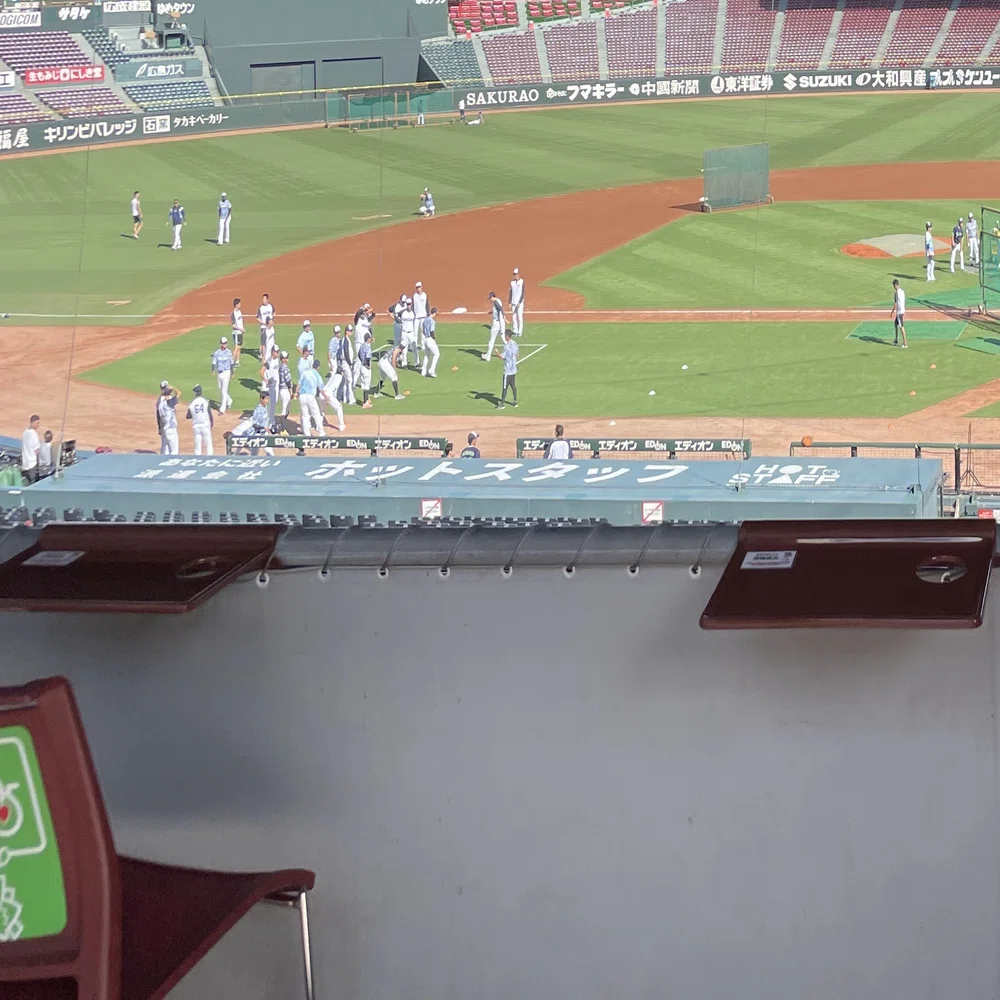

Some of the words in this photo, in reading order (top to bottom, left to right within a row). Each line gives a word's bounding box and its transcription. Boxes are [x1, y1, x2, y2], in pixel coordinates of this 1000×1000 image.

[58, 6, 91, 20] サタケ
[157, 2, 195, 15] ゆめタウン
[29, 70, 60, 82] 生もみじ
[147, 64, 185, 77] 広島ガス
[725, 74, 773, 92] 東洋証券
[799, 74, 852, 88] SUZUKI
[872, 69, 926, 88] 大和興産
[466, 88, 539, 106] SAKURAO
[567, 83, 624, 101] フマキラー
[173, 113, 229, 127] タカキベーカリー
[44, 118, 137, 143] キリンビバレッジ
[231, 437, 268, 448] エディオン
[302, 438, 340, 449] エディオン
[374, 439, 412, 450] エディオン
[523, 440, 548, 451] エディ
[598, 440, 637, 451] エディオン
[674, 440, 713, 451] エディオン
[305, 459, 690, 485] ホットスタッフ
